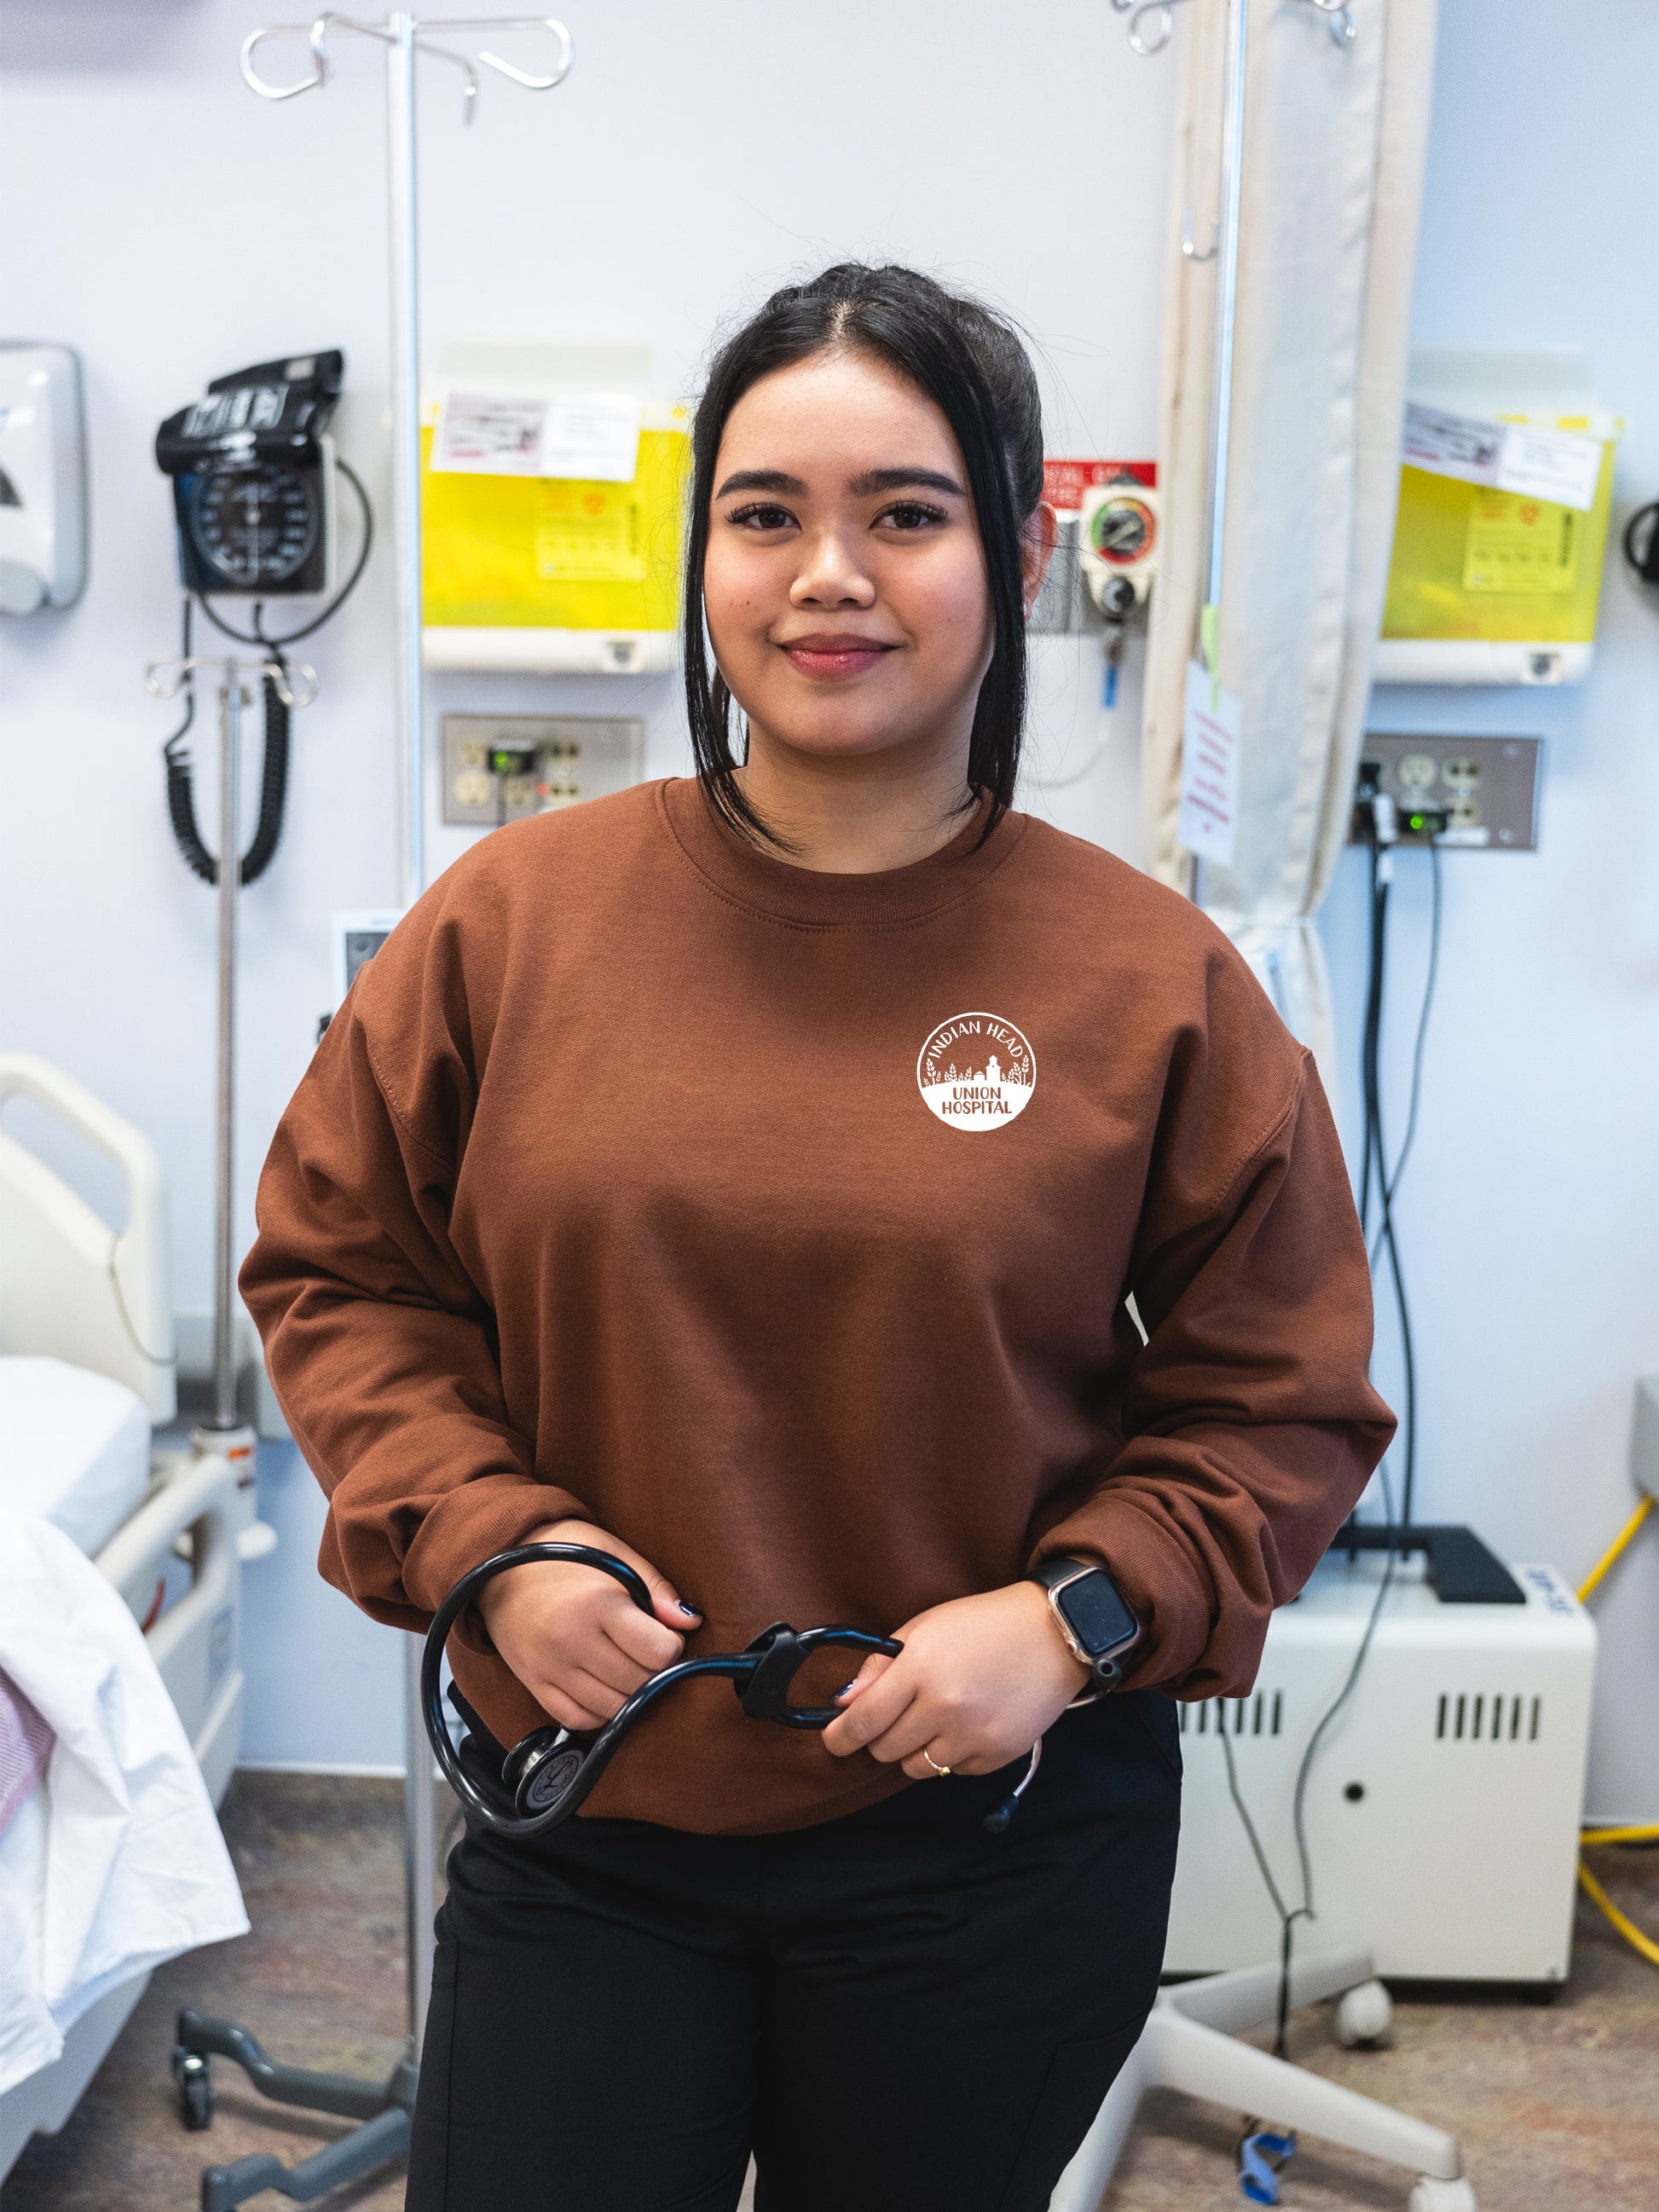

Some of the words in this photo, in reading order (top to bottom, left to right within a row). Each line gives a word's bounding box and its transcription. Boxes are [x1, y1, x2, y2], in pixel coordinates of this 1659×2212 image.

[928, 1020, 980, 1059] INDIAN
[986, 1022, 1023, 1057] HEAD
[952, 1087, 1002, 1100] UNION
[942, 1100, 1013, 1114] HOSPITAL
